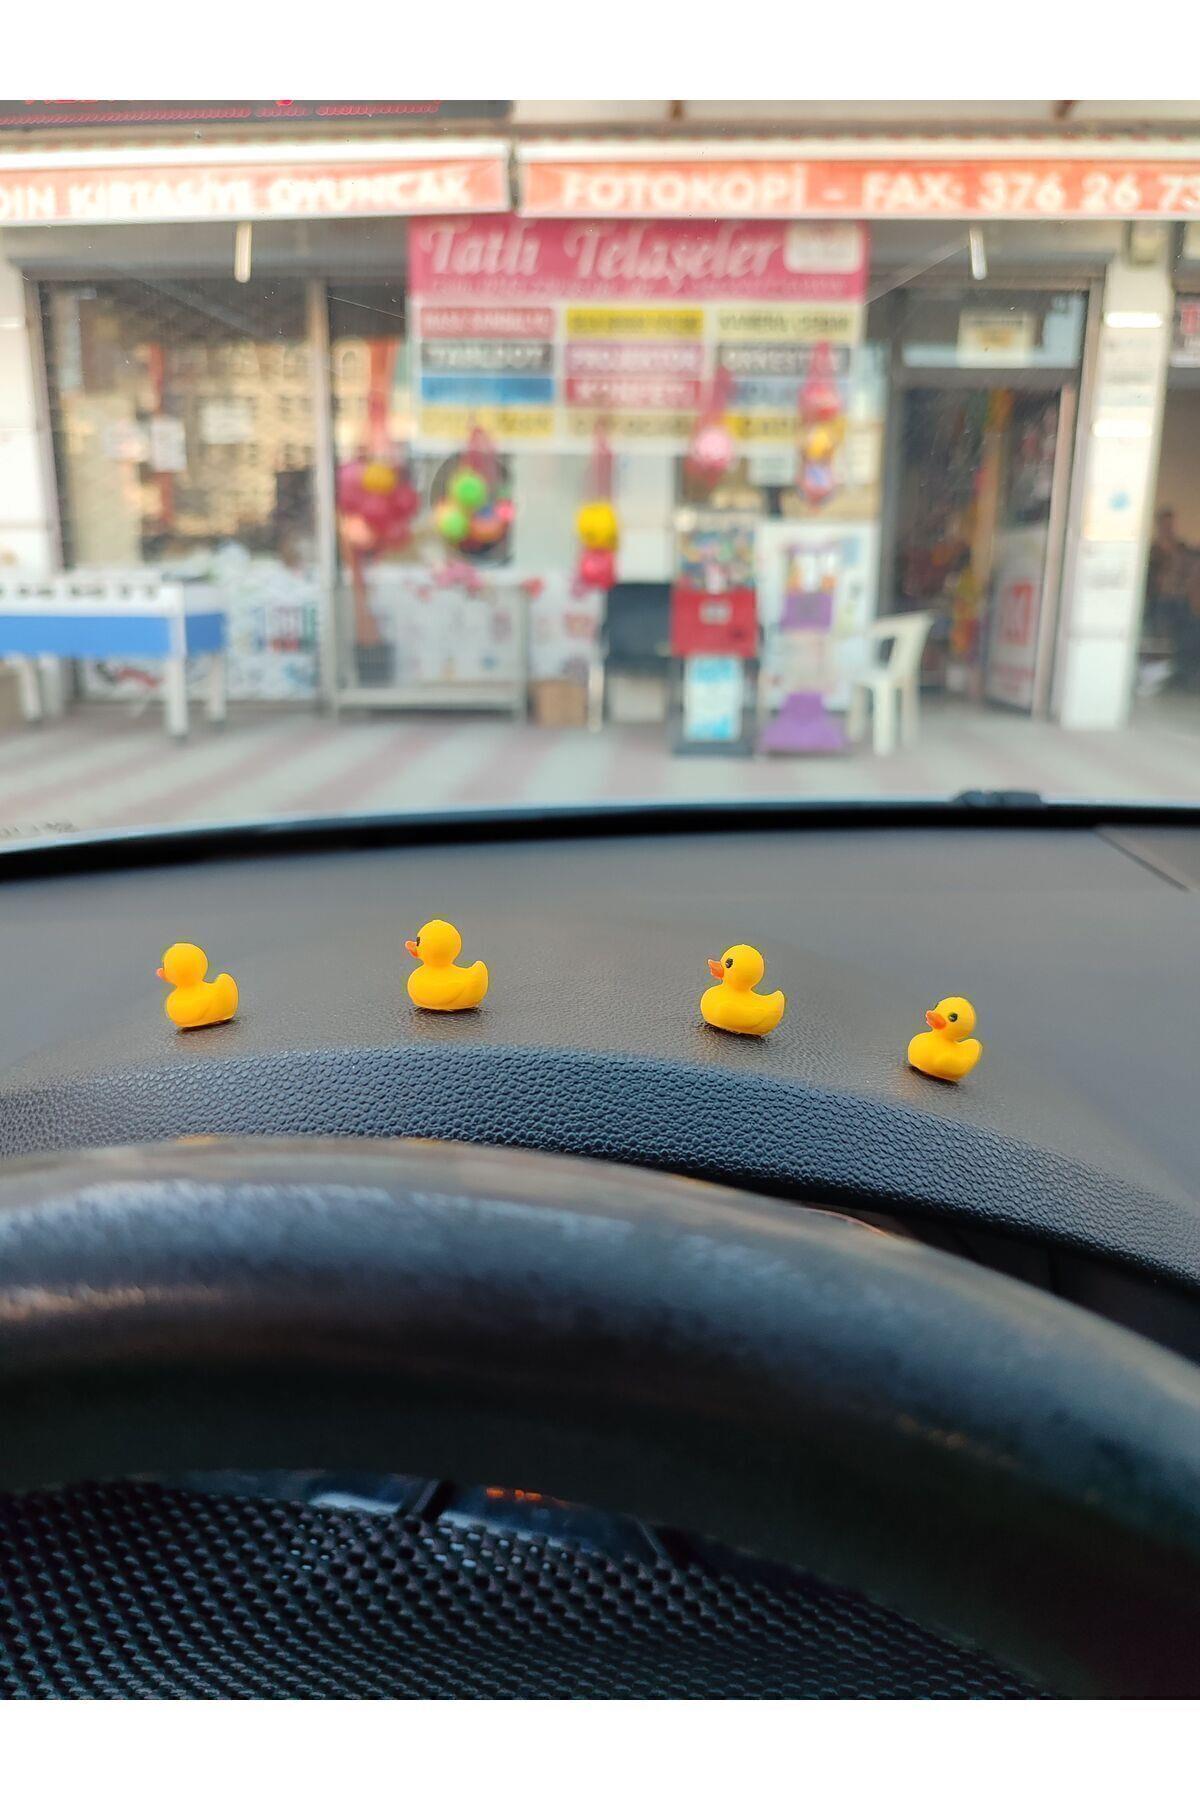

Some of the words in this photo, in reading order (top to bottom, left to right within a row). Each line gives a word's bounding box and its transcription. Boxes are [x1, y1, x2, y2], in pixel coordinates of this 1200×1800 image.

[267, 169, 474, 214] OYUNCAK
[977, 170, 1067, 211] 376
[1081, 171, 1142, 211] 26
